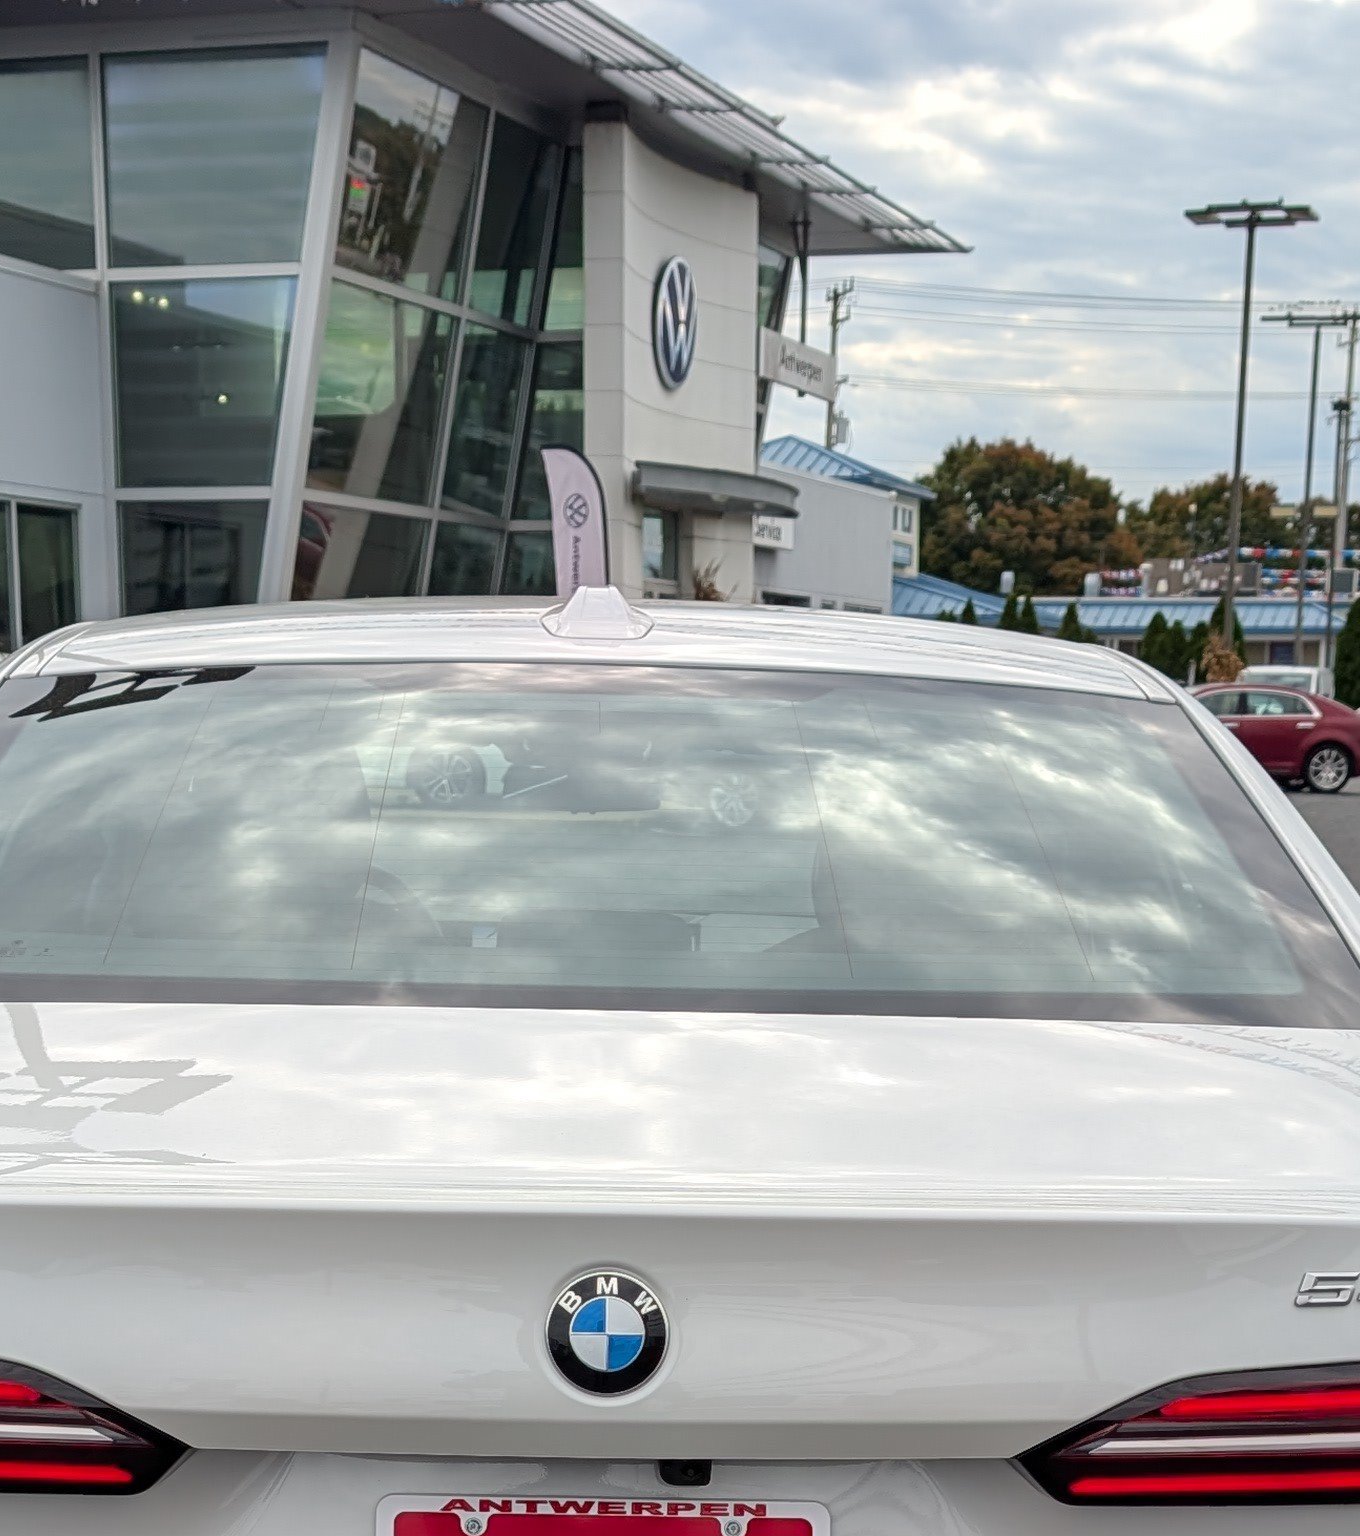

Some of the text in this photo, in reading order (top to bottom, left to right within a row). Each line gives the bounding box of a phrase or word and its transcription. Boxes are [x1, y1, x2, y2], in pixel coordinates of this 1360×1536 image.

[780, 343, 824, 384] Antwerpen
[558, 1276, 658, 1315] BMW
[439, 1498, 768, 1518] ANTWERPEN
